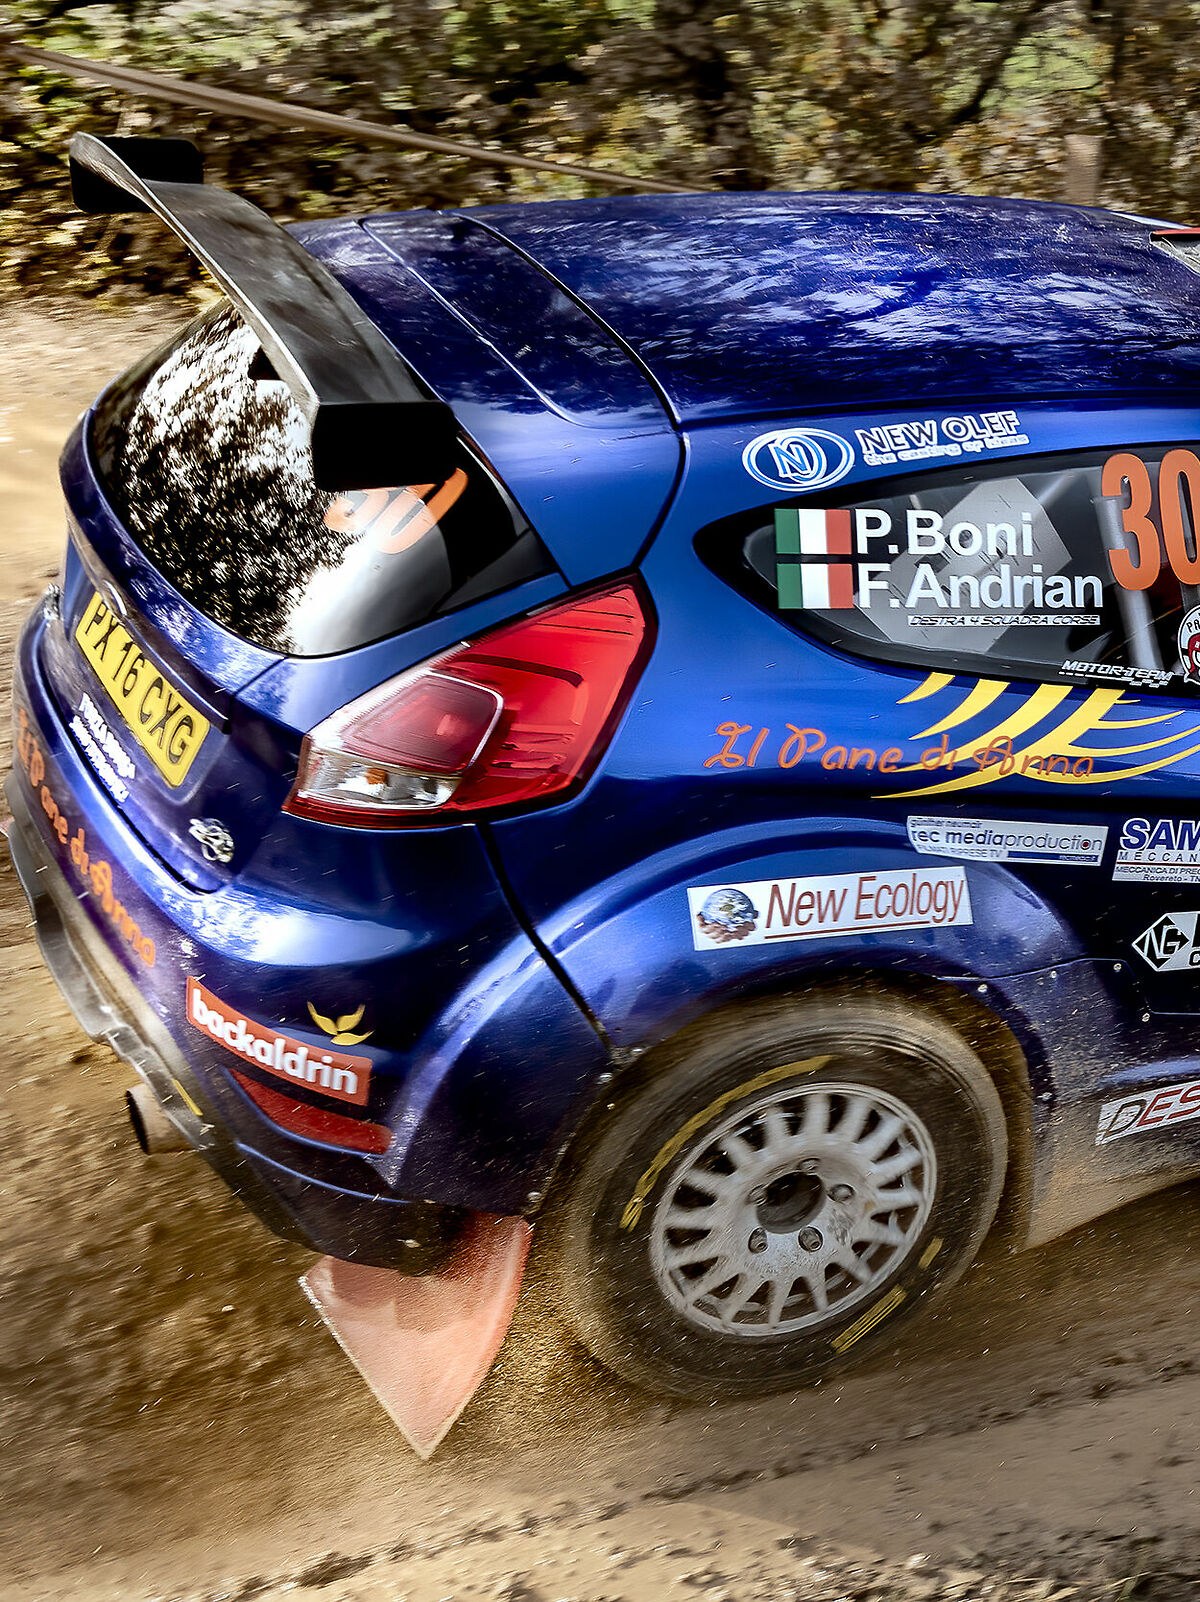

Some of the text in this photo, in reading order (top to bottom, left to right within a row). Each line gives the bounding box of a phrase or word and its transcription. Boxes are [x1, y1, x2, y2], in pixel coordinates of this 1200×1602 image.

[854, 410, 1021, 453] NEW OLEF
[856, 510, 1034, 556] P.Boni
[857, 563, 1103, 609] F.Andrian
[910, 615, 1098, 626] DESTRA 4 SQUADRA CORSE
[139, 677, 194, 765] CXG
[777, 723, 903, 774] Pane
[920, 733, 954, 771] di
[971, 735, 1094, 778] Anna
[1116, 866, 1169, 875] MECCANICA
[1170, 867, 1179, 875] DI
[765, 872, 965, 928] New Ecology
[192, 988, 358, 1095] backaldrin
